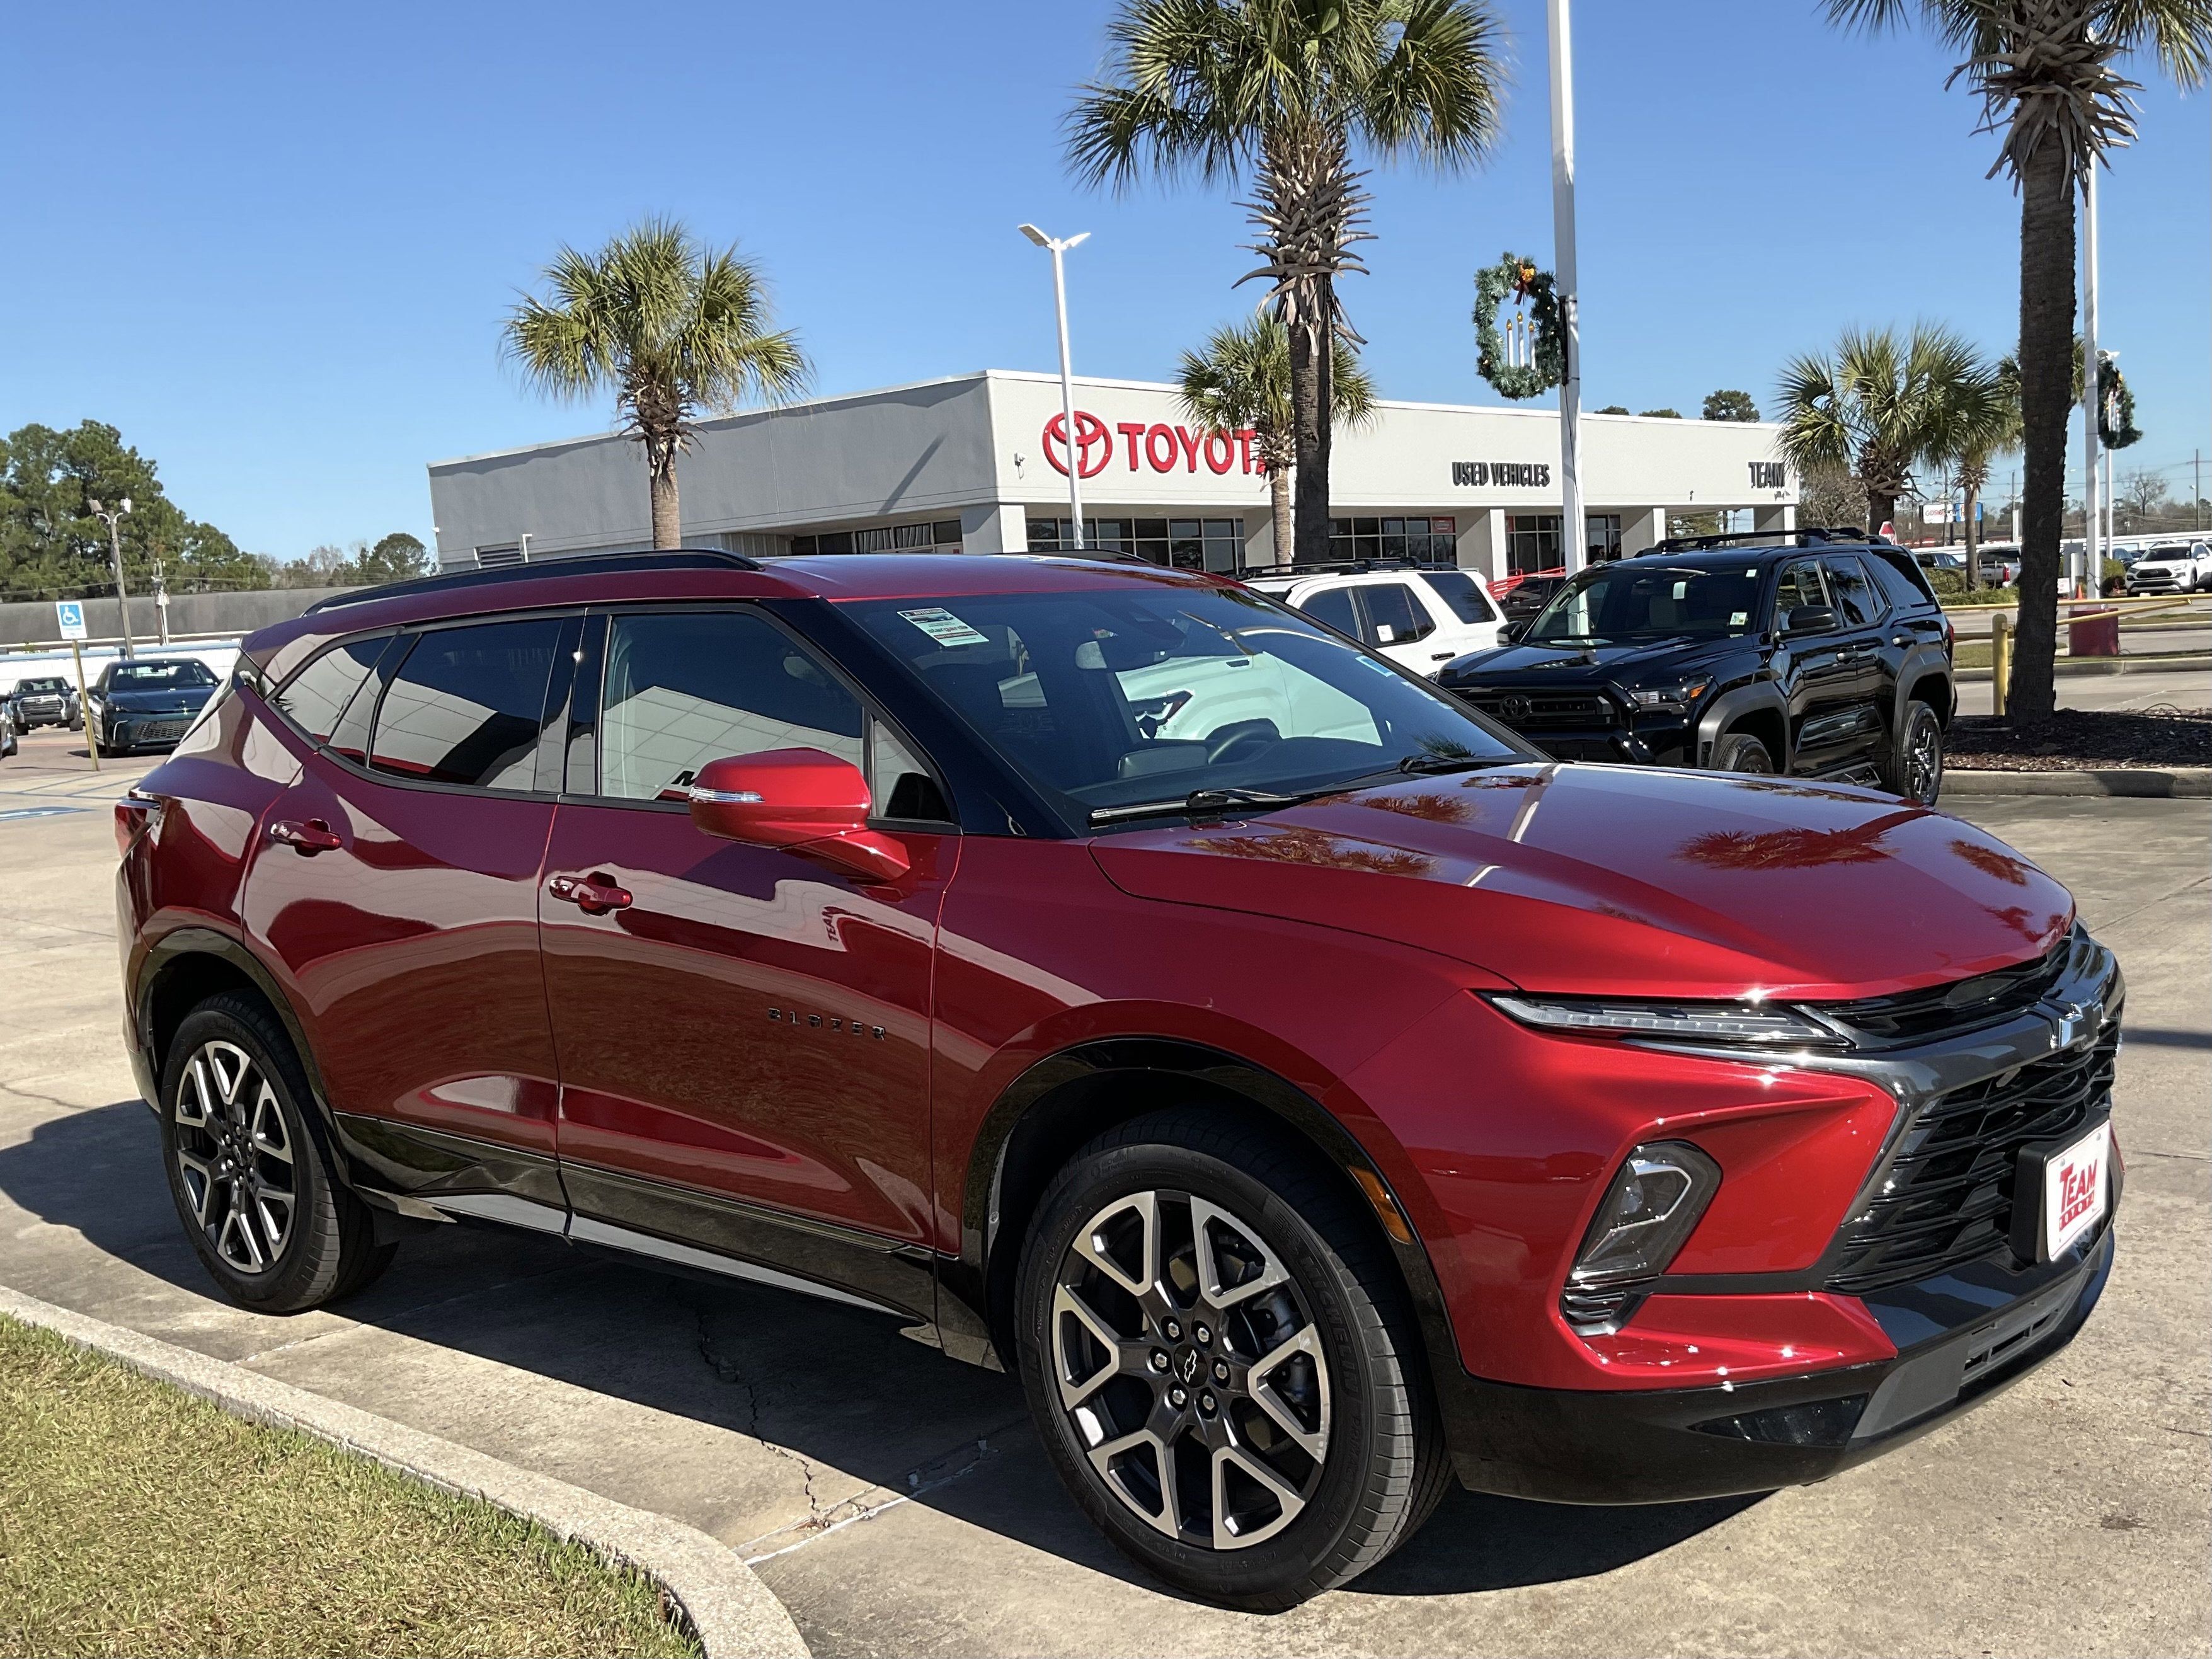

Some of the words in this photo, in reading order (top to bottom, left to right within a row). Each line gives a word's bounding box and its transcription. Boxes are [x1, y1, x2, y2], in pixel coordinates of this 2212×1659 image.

[1117, 423, 1265, 475] TOYOT
[1452, 461, 1489, 486] USED
[1490, 462, 1550, 487] VEHICLES
[1748, 461, 1785, 489] TEAM
[767, 1007, 886, 1041] BLAZER
[2060, 1158, 2097, 1214] TEAM
[2059, 1191, 2095, 1230] TOYOTA
[1297, 1254, 1359, 1393] MICHELIN
